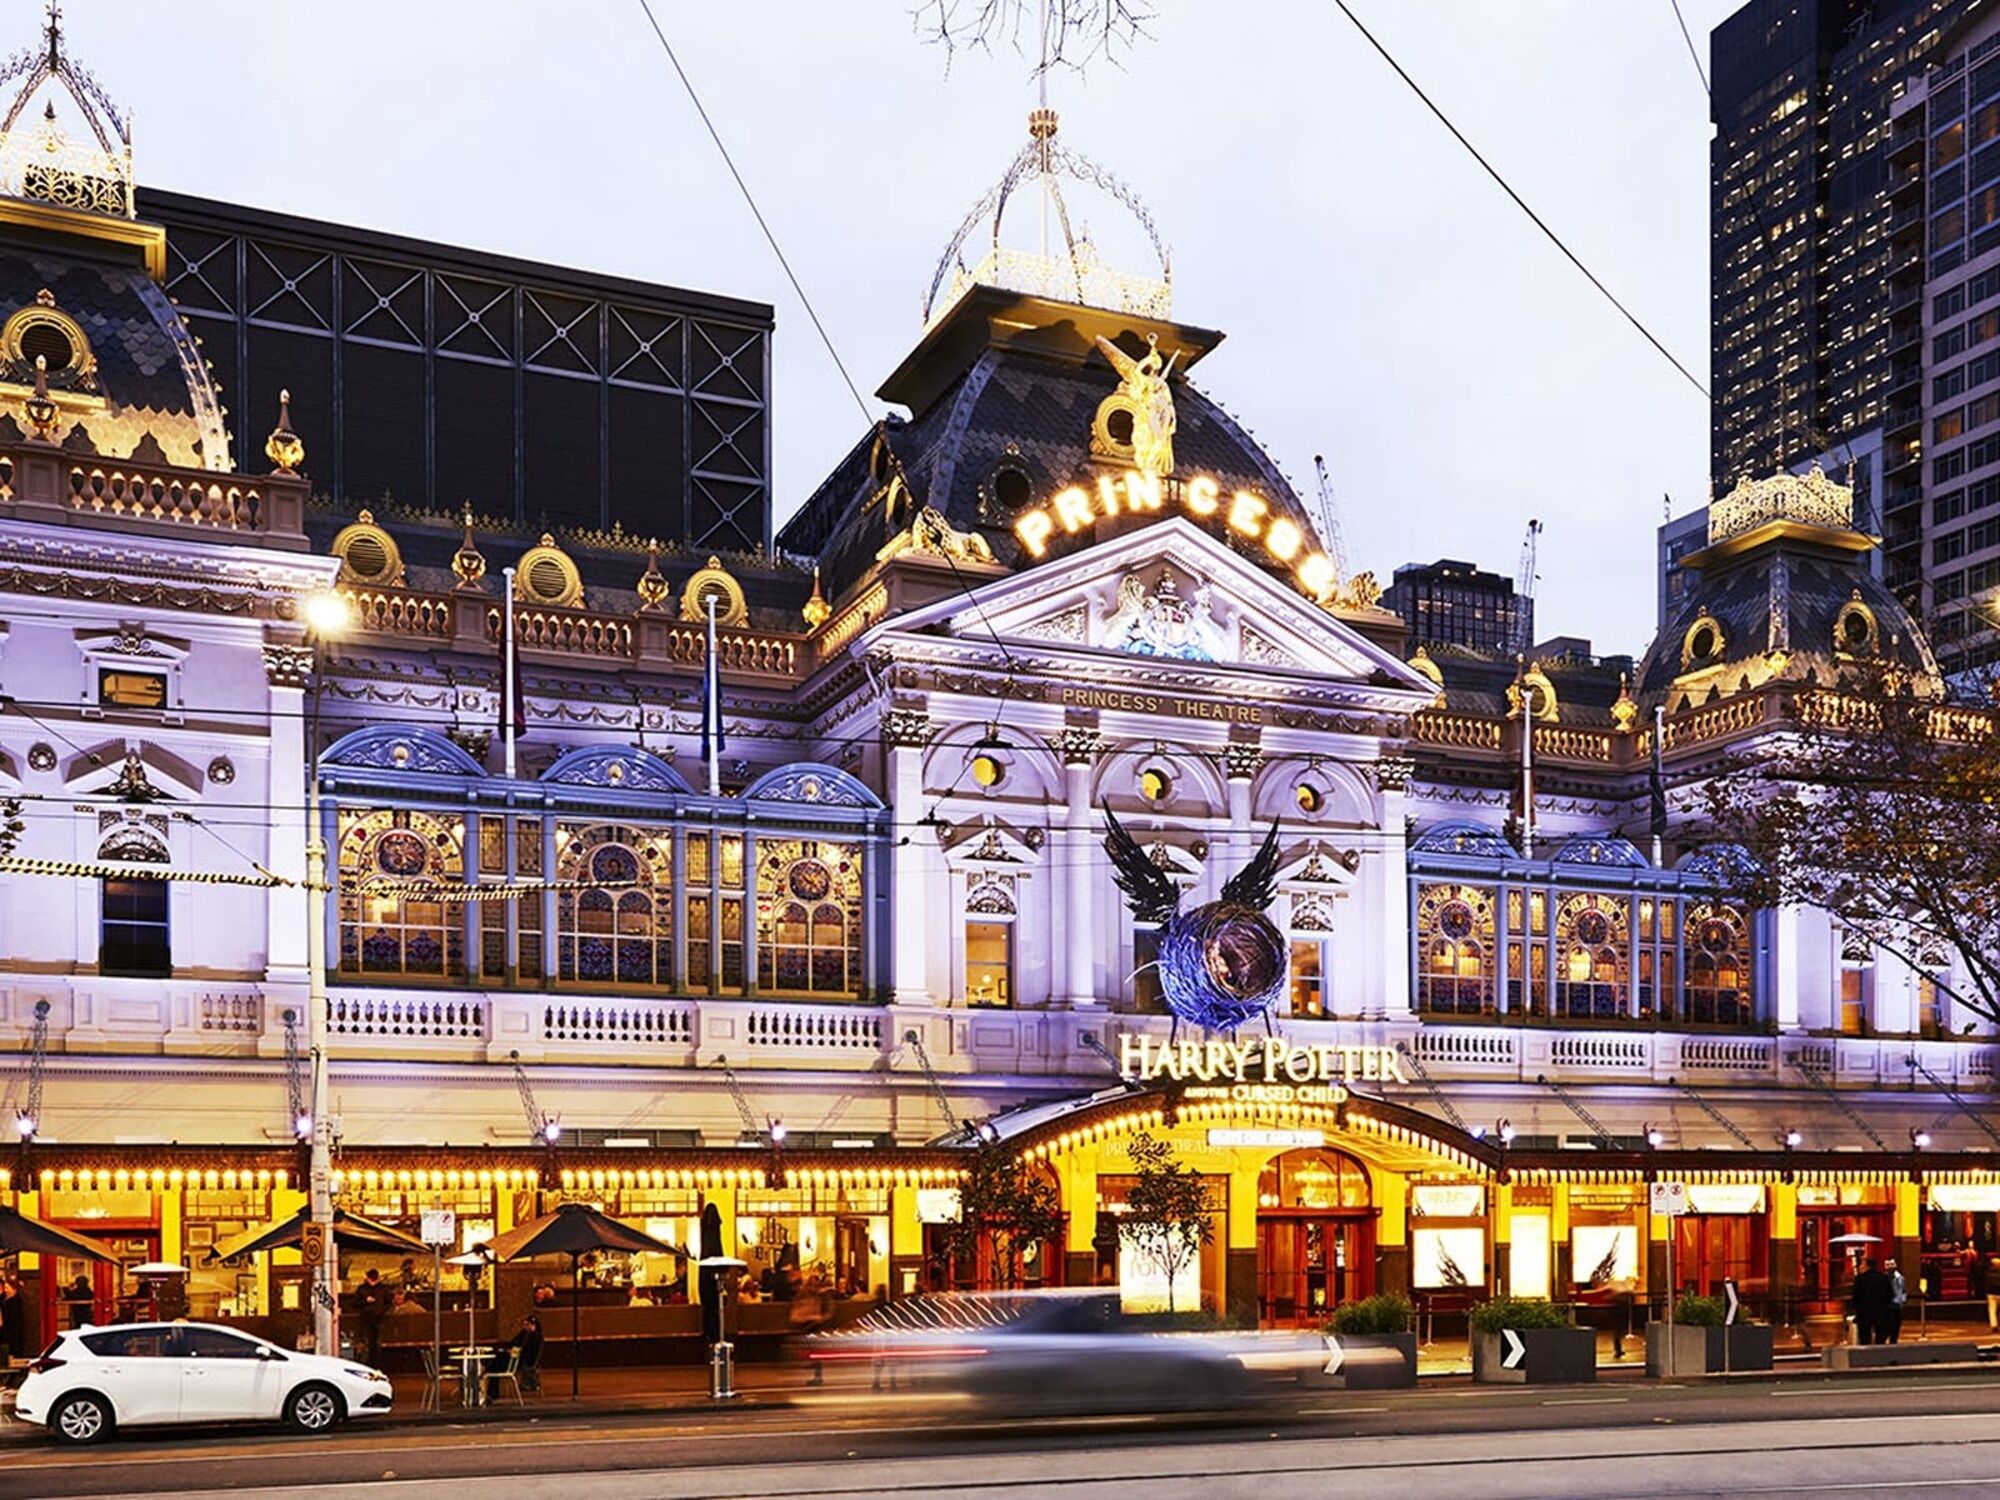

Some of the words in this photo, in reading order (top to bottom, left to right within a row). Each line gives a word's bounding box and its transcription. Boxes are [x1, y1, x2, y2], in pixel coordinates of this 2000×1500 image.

[1014, 469, 1337, 601] PRINCESS
[1061, 687, 1165, 712] PRINCESS'
[1174, 699, 1263, 723] THEATRE
[1117, 1033, 1255, 1082] HARRY
[1261, 1037, 1409, 1084] POTTER
[1231, 1084, 1294, 1102] CURSED
[1296, 1085, 1348, 1104] CHILD
